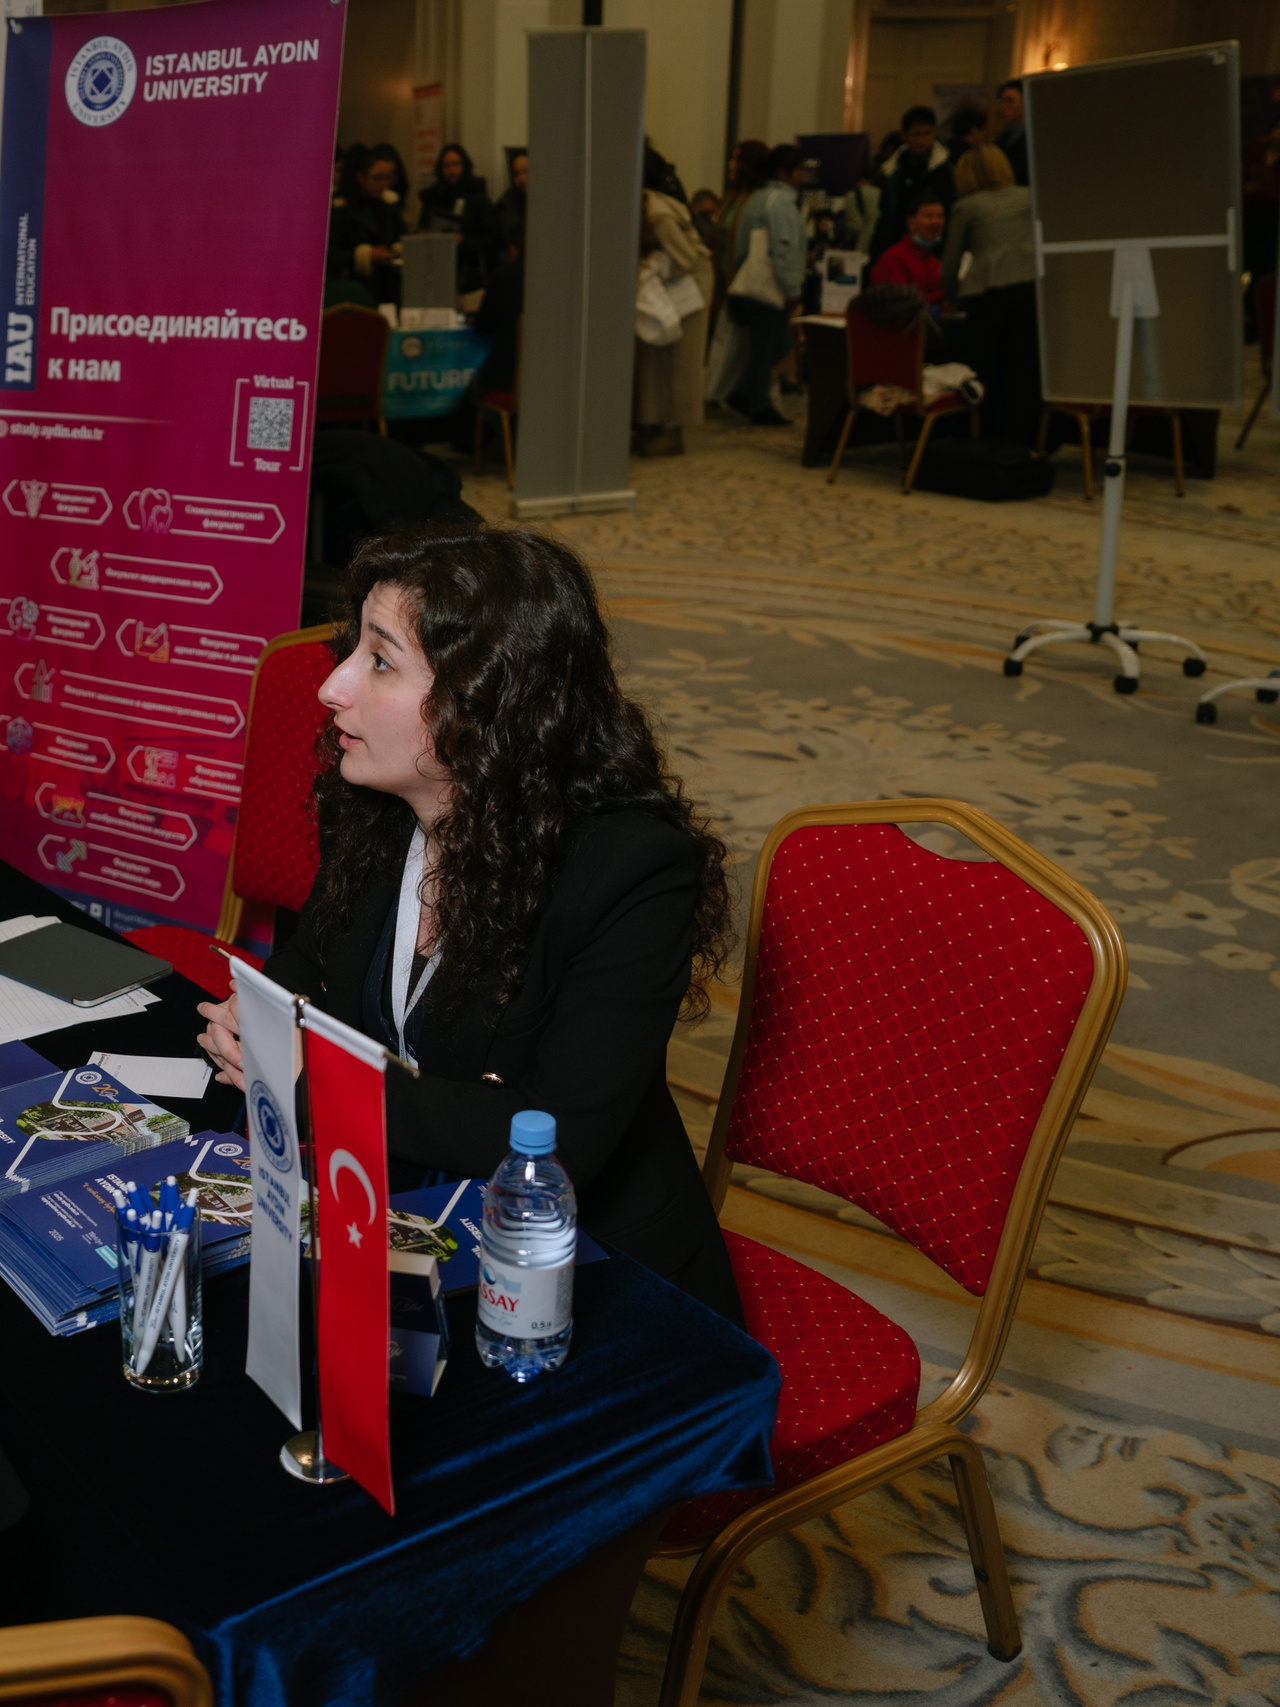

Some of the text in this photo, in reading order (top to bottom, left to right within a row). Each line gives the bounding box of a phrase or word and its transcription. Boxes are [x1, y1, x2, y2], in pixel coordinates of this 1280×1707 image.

[145, 39, 320, 76] ISTANBUL AYDIN
[143, 71, 269, 102] UNIVERSITY
[15, 213, 29, 306] INTERNATIONAL
[25, 238, 37, 306] EDUCATION
[50, 306, 308, 344] Присоединяйтесь
[4, 311, 34, 383] IAU
[47, 357, 121, 382] к нам
[253, 374, 295, 389] Virtual
[254, 457, 282, 472] Tour
[94, 1175, 115, 1193] AYDIN
[258, 1164, 292, 1209] ISTANBUL
[257, 1191, 293, 1243] UNIVERSITY
[266, 1189, 286, 1218] AYDIN
[48, 1229, 64, 1242] 2025
[155, 1287, 167, 1315] ISTANBUL
[169, 1239, 181, 1270] UNIVERSITY
